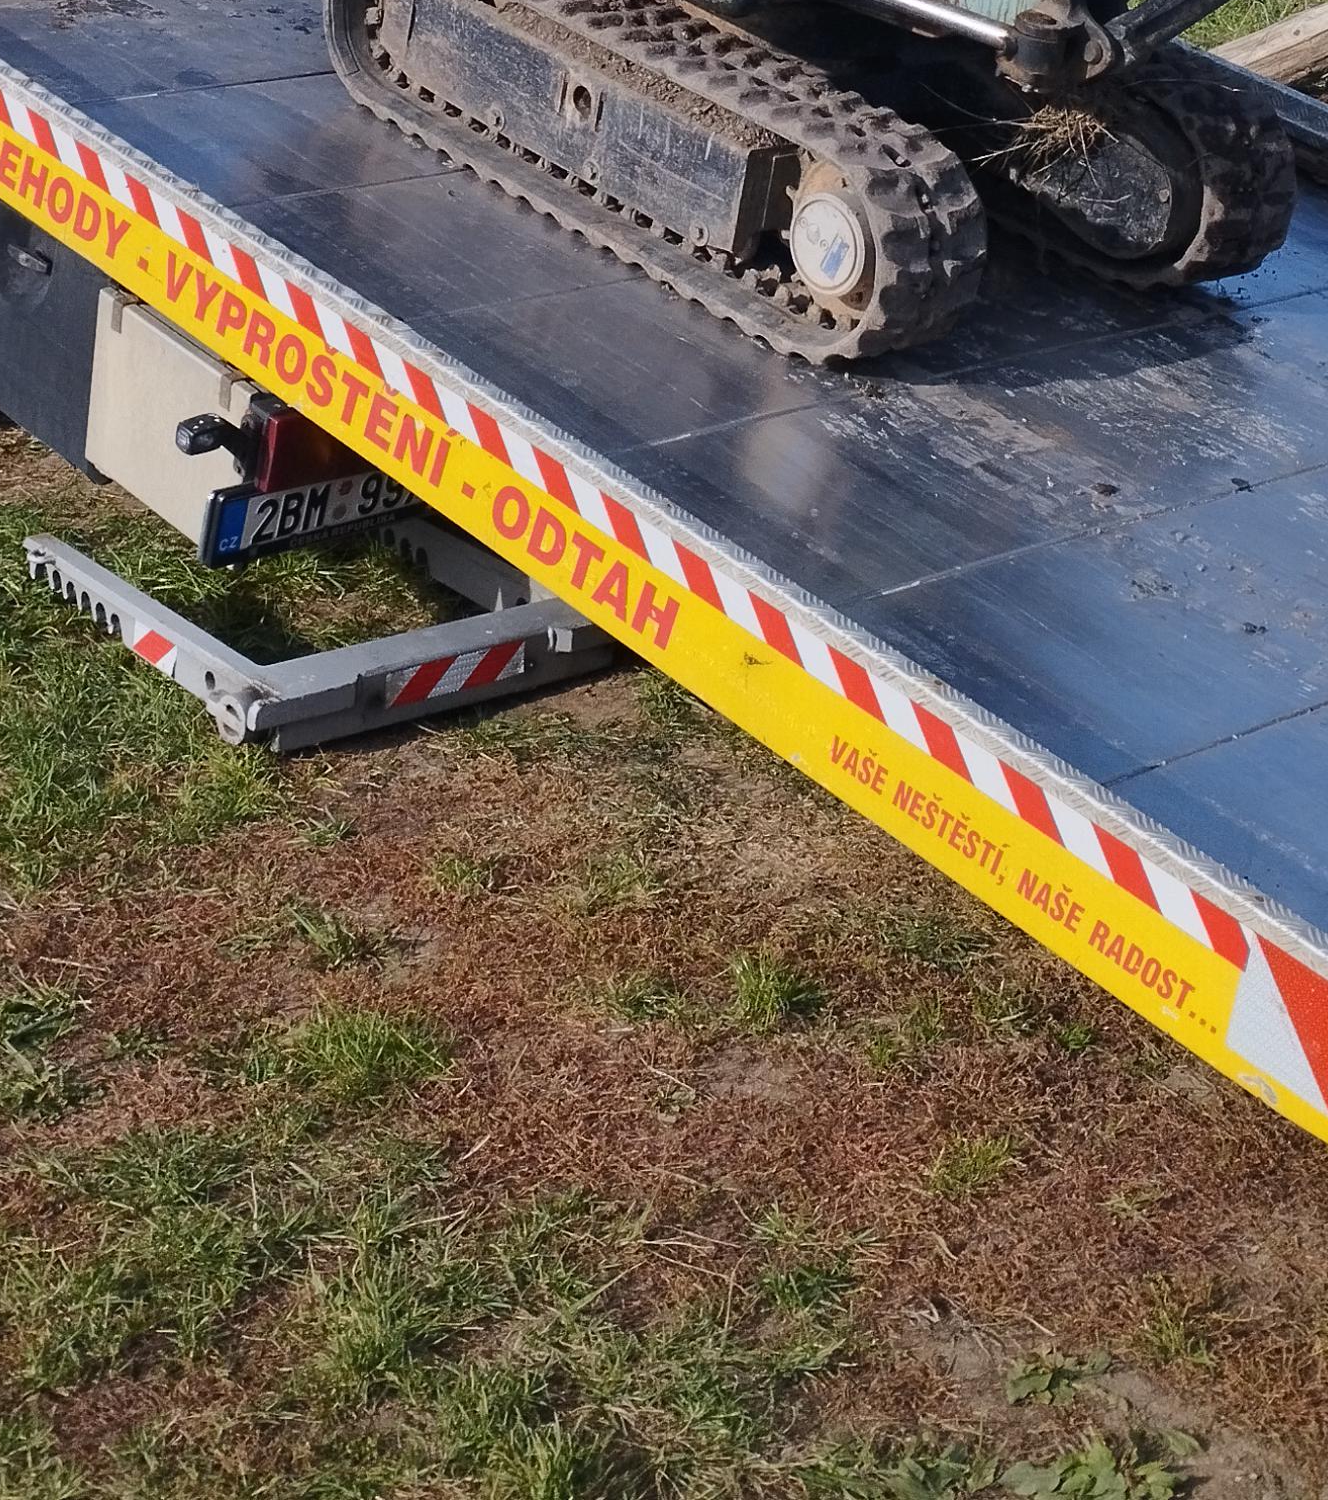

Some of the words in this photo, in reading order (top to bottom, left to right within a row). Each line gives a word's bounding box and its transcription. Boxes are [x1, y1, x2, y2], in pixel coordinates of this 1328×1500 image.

[167, 250, 460, 488] VYPROŠTĚNÍ
[492, 485, 680, 650] ODTAH
[250, 483, 332, 545] 2BM
[358, 472, 415, 514] 99
[219, 536, 237, 551] CZ
[829, 735, 889, 795] VAŠE
[892, 780, 1011, 885] NEŠTĚSTÍ,
[1016, 868, 1085, 934] NAŠE
